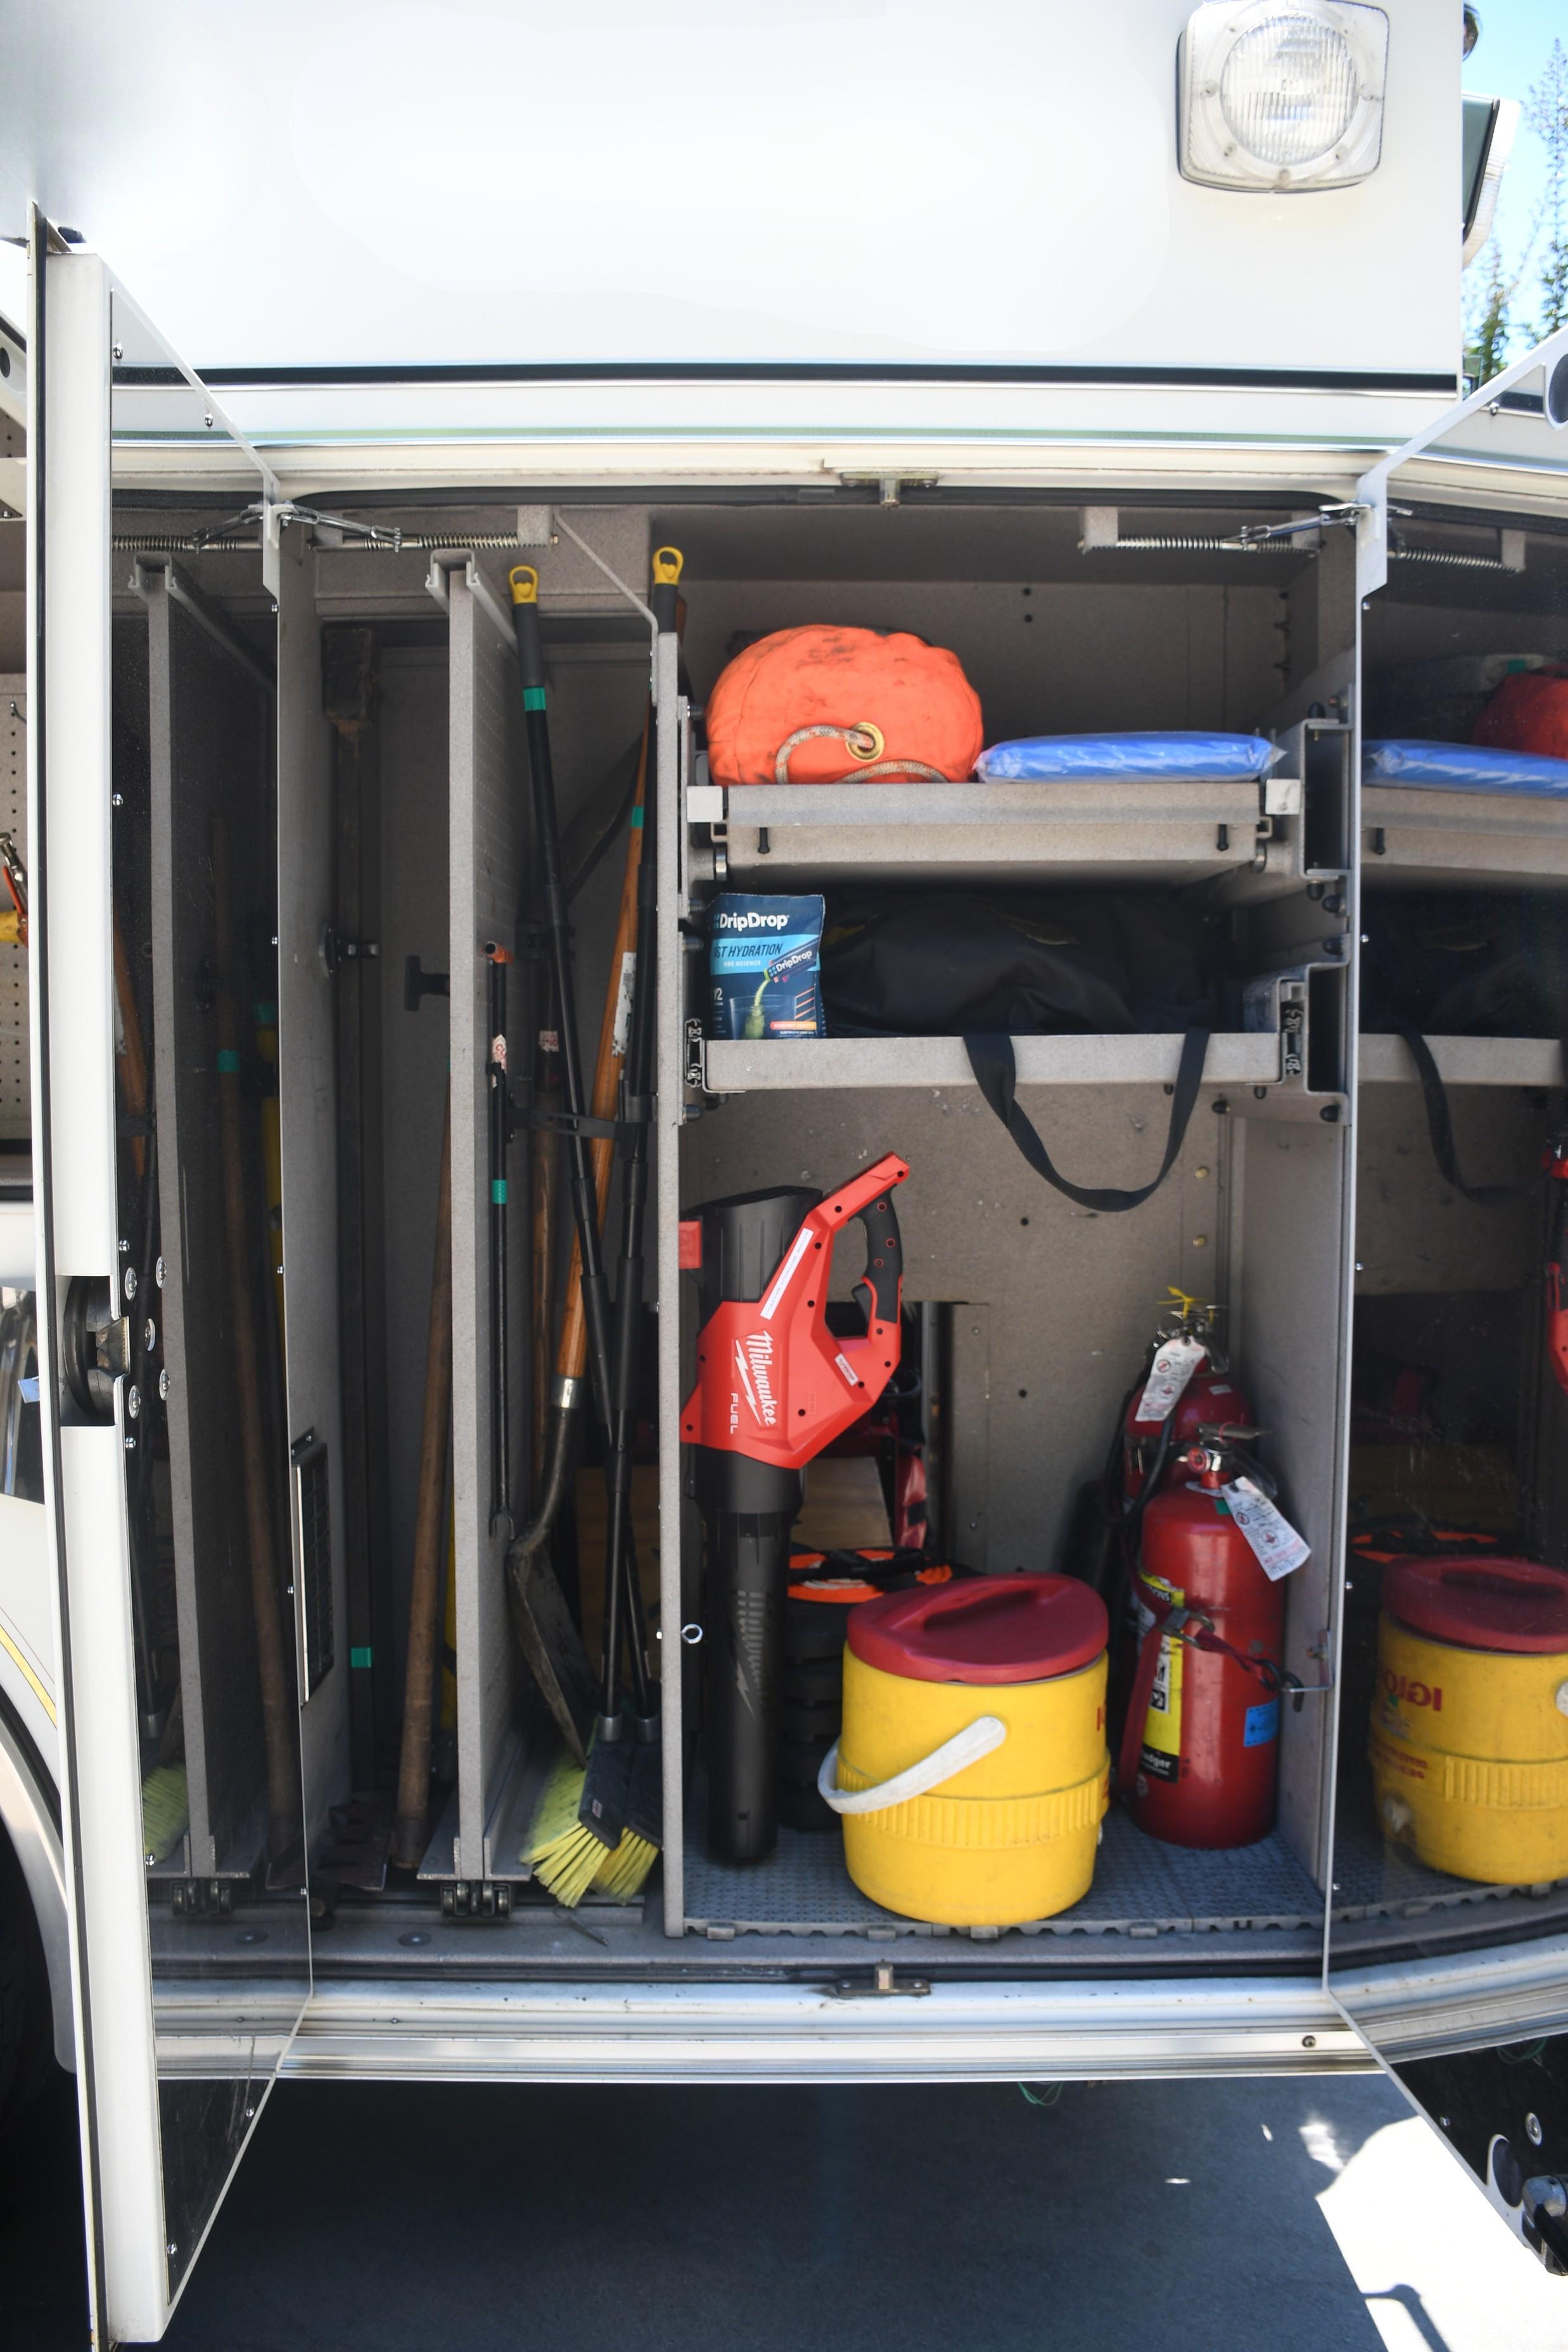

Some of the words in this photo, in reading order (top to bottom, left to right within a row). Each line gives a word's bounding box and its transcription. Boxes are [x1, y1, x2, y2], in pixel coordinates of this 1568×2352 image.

[720, 912, 788, 931] DripDrop
[713, 946, 727, 958] ST
[728, 943, 783, 957] HYDRATION
[775, 951, 812, 972] DripDrop
[746, 1330, 777, 1426] Milwaukee
[730, 1393, 739, 1434] FUEL
